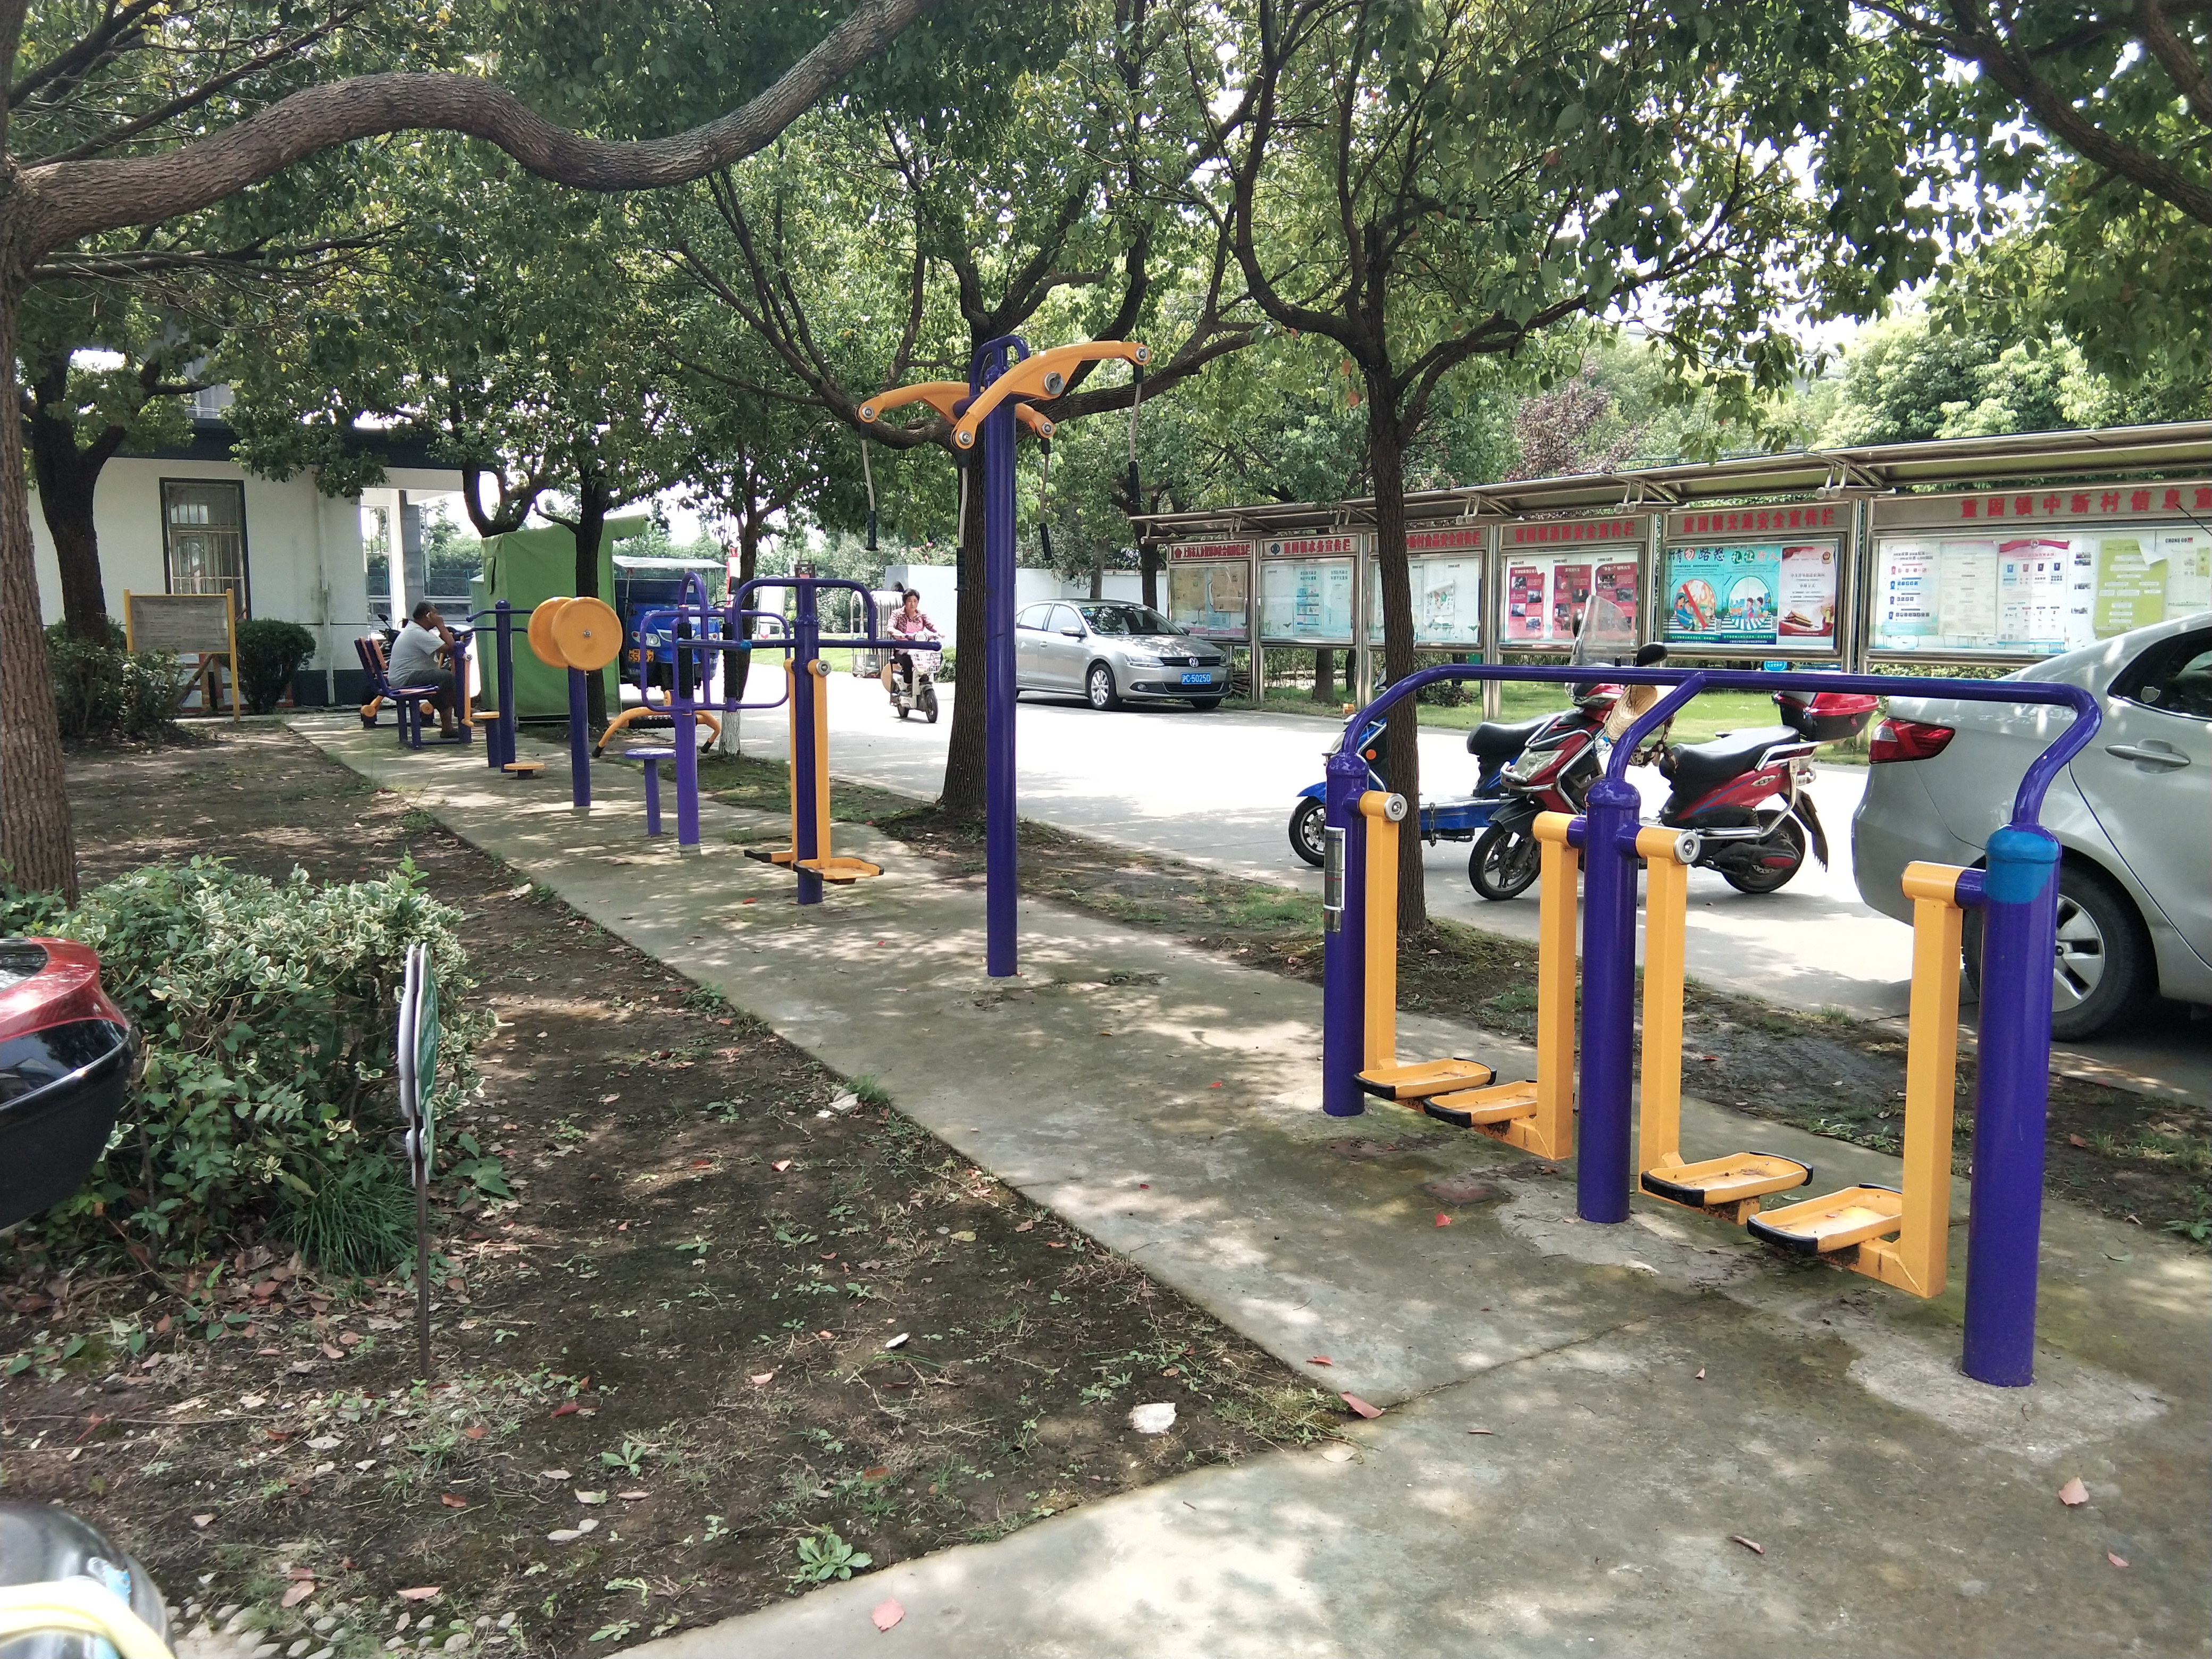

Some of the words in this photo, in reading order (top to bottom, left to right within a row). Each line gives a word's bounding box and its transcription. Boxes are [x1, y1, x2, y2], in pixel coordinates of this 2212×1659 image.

[1683, 507, 1834, 533] 重固镇交通安全宣传栏
